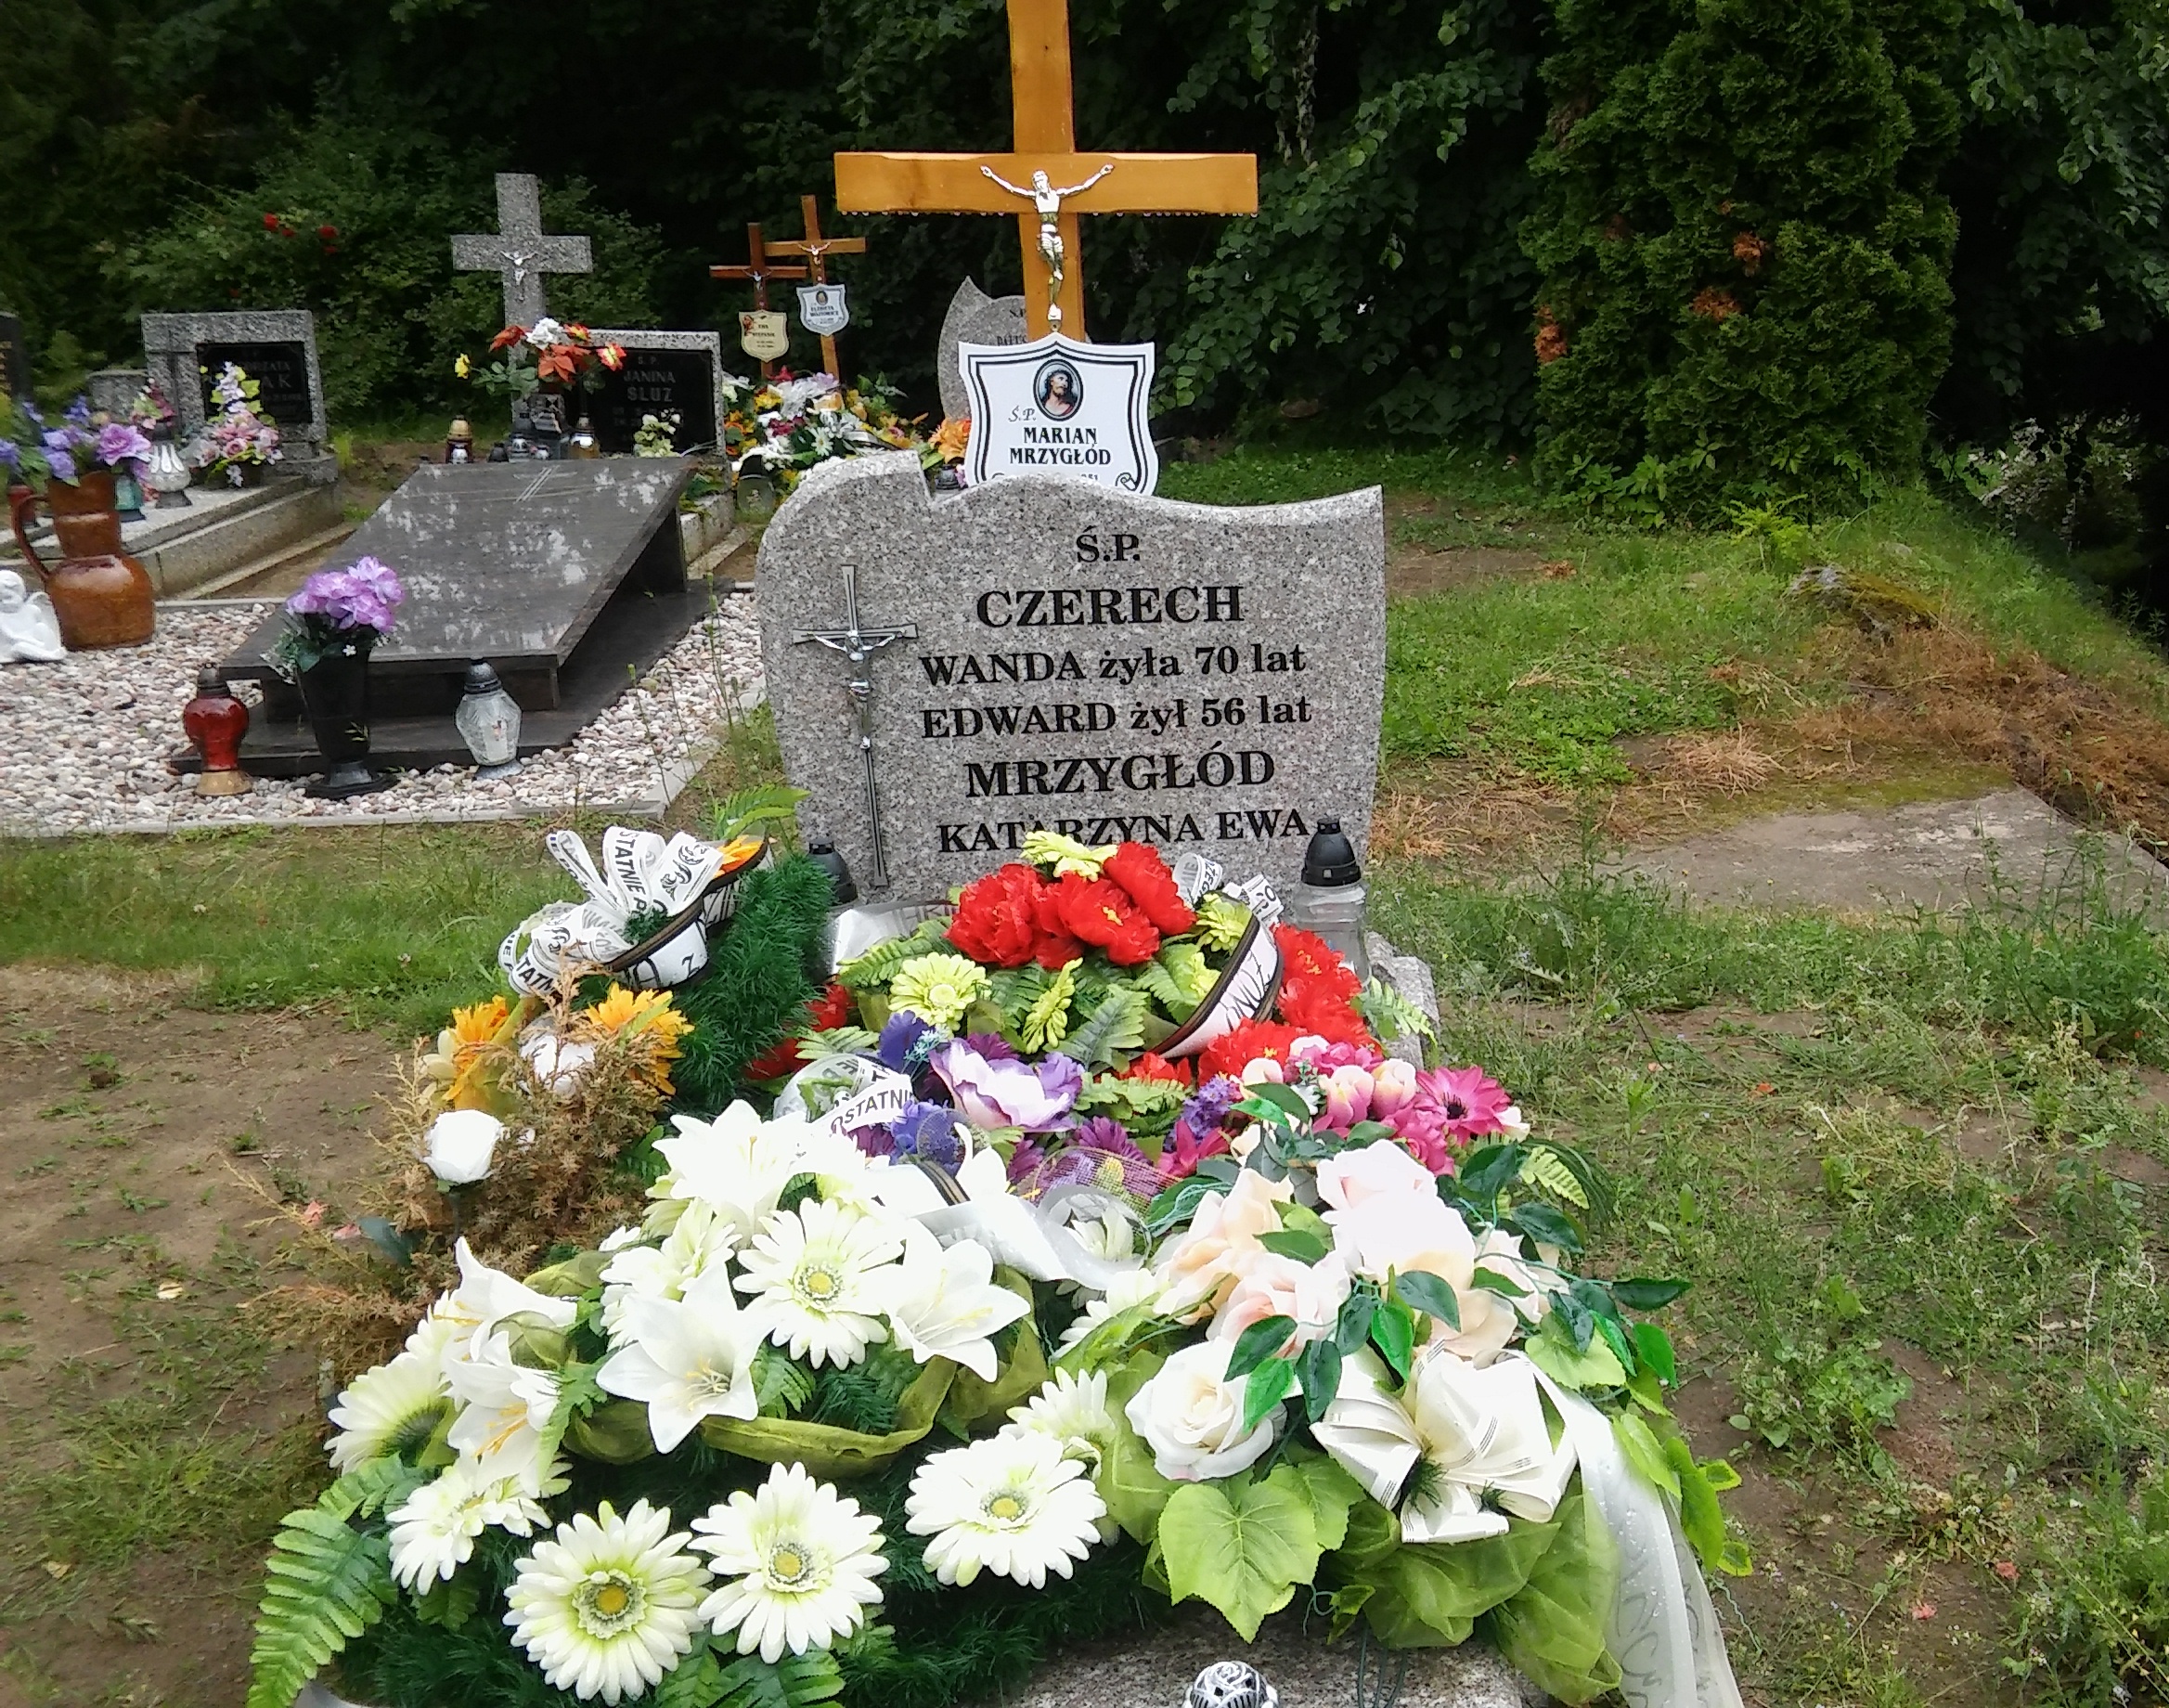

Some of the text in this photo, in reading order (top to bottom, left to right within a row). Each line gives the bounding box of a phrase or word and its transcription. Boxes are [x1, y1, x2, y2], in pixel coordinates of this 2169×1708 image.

[623, 370, 677, 383] JANINA
[1024, 427, 1097, 444] MARIAN
[1010, 444, 1111, 465] MRZYGŁÓD
[976, 586, 1245, 628] CZERECH
[920, 644, 1306, 687] WANDA żyła 70 lat
[921, 694, 1311, 738] EDWARD żył 56 lat
[965, 740, 1275, 798] MRZYGŁÓD
[1217, 808, 1310, 840] EWA
